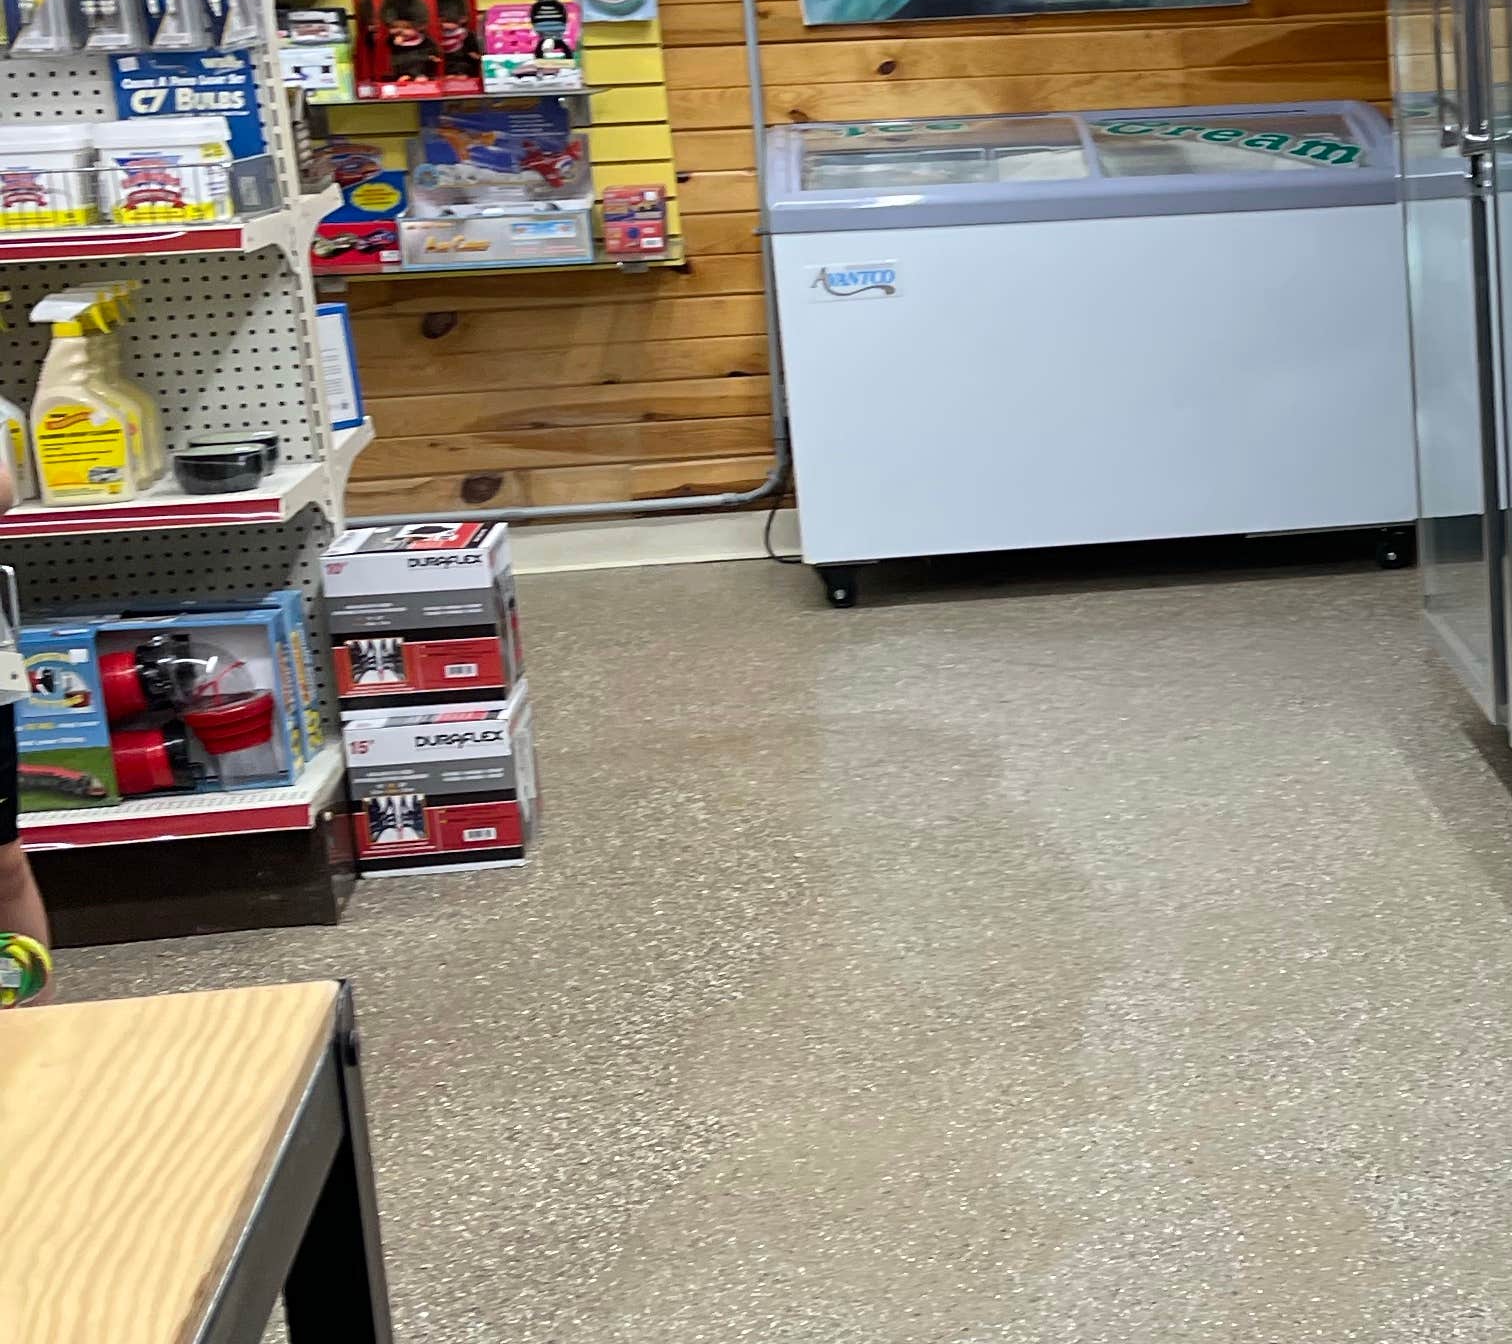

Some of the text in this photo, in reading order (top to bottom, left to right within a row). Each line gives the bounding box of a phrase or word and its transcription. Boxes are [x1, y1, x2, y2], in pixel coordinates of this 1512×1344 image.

[1090, 121, 1361, 165] Cream
[407, 555, 483, 569] DURAFLEX
[415, 729, 504, 748] DURAFLEX
